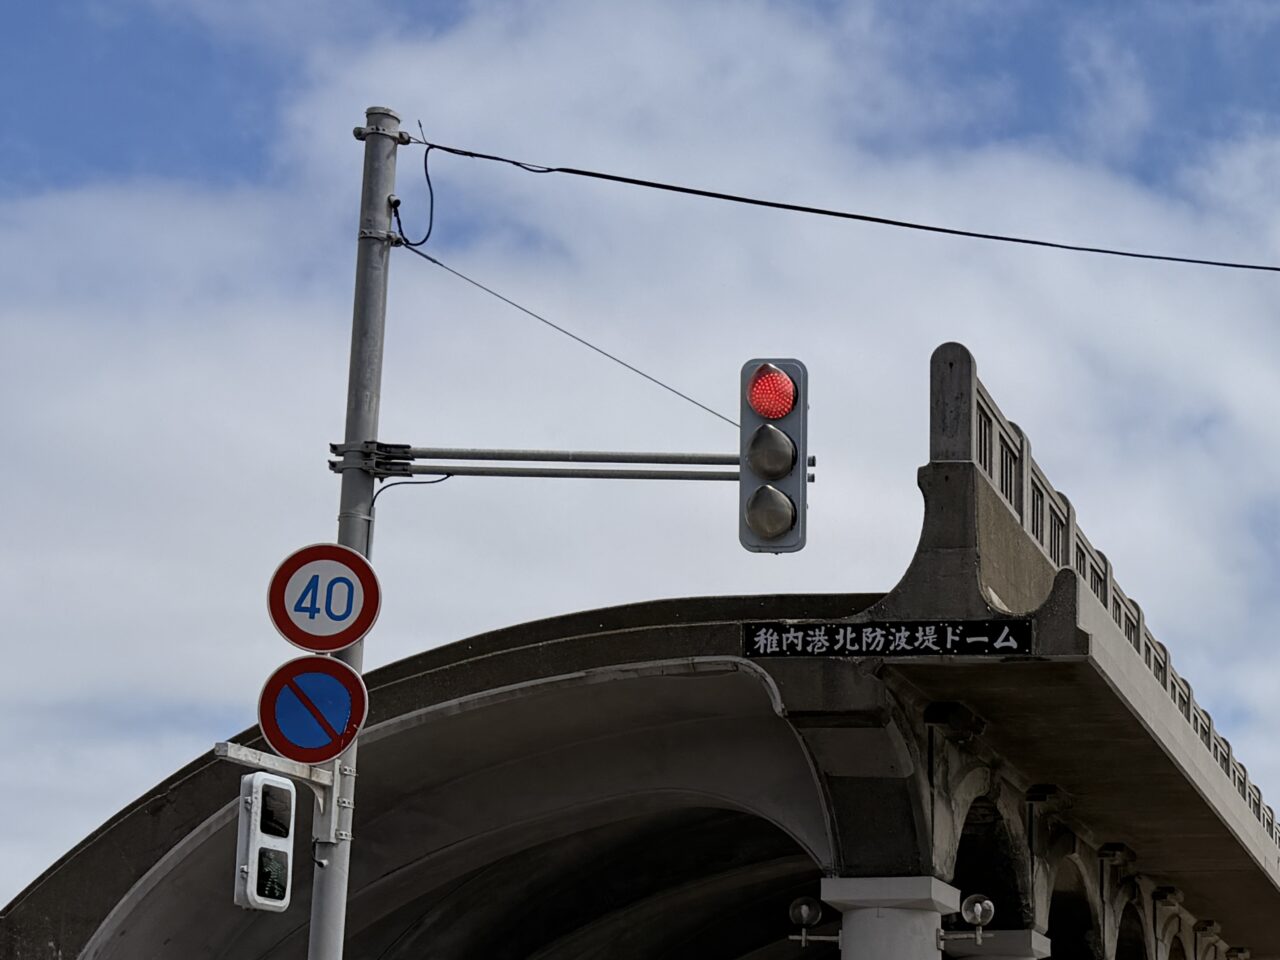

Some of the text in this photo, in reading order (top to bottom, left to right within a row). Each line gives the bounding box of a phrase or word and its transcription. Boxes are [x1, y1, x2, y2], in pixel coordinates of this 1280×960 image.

[294, 574, 354, 621] 40
[754, 625, 1018, 655] 稚内港北防波堤ドーム
